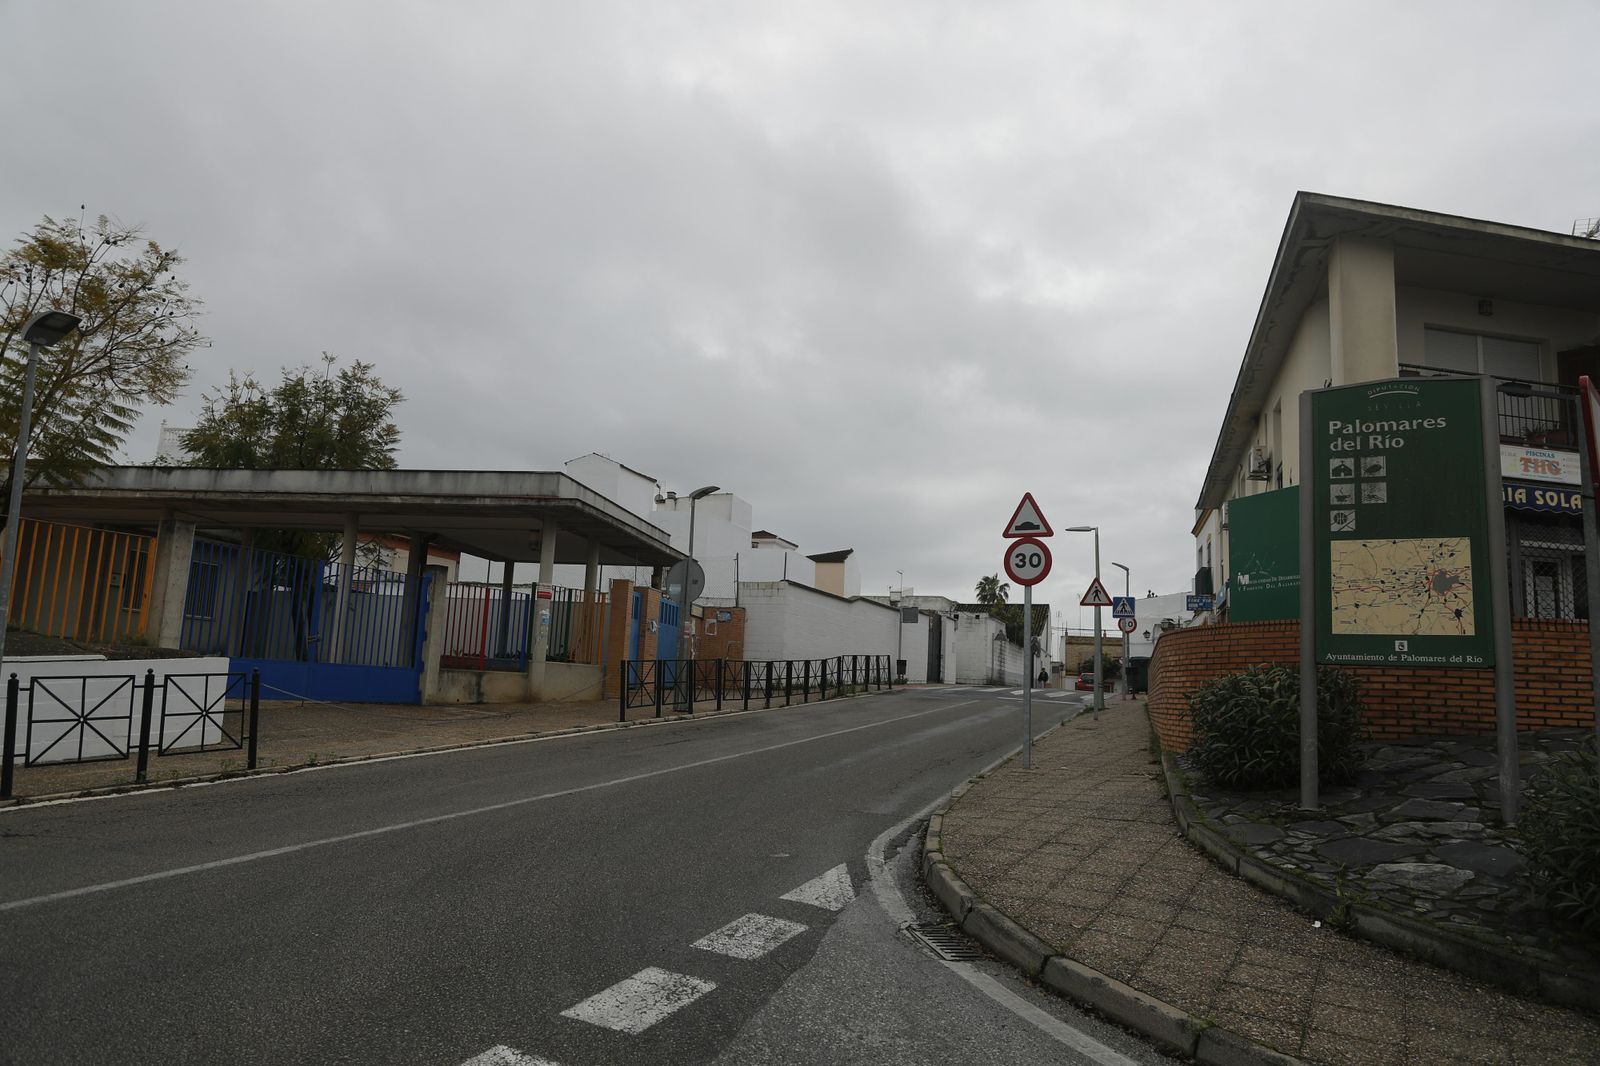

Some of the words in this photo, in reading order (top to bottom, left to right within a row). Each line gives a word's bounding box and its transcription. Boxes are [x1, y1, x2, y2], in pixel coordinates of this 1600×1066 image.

[1328, 416, 1447, 435] Palomares
[1329, 435, 1361, 452] del
[1368, 435, 1405, 450] Río
[1014, 552, 1042, 569] 30
[1325, 652, 1385, 662] Ayuntamiento
[1388, 653, 1398, 662] de
[1401, 653, 1447, 663] Palomares
[1449, 654, 1463, 663] del
